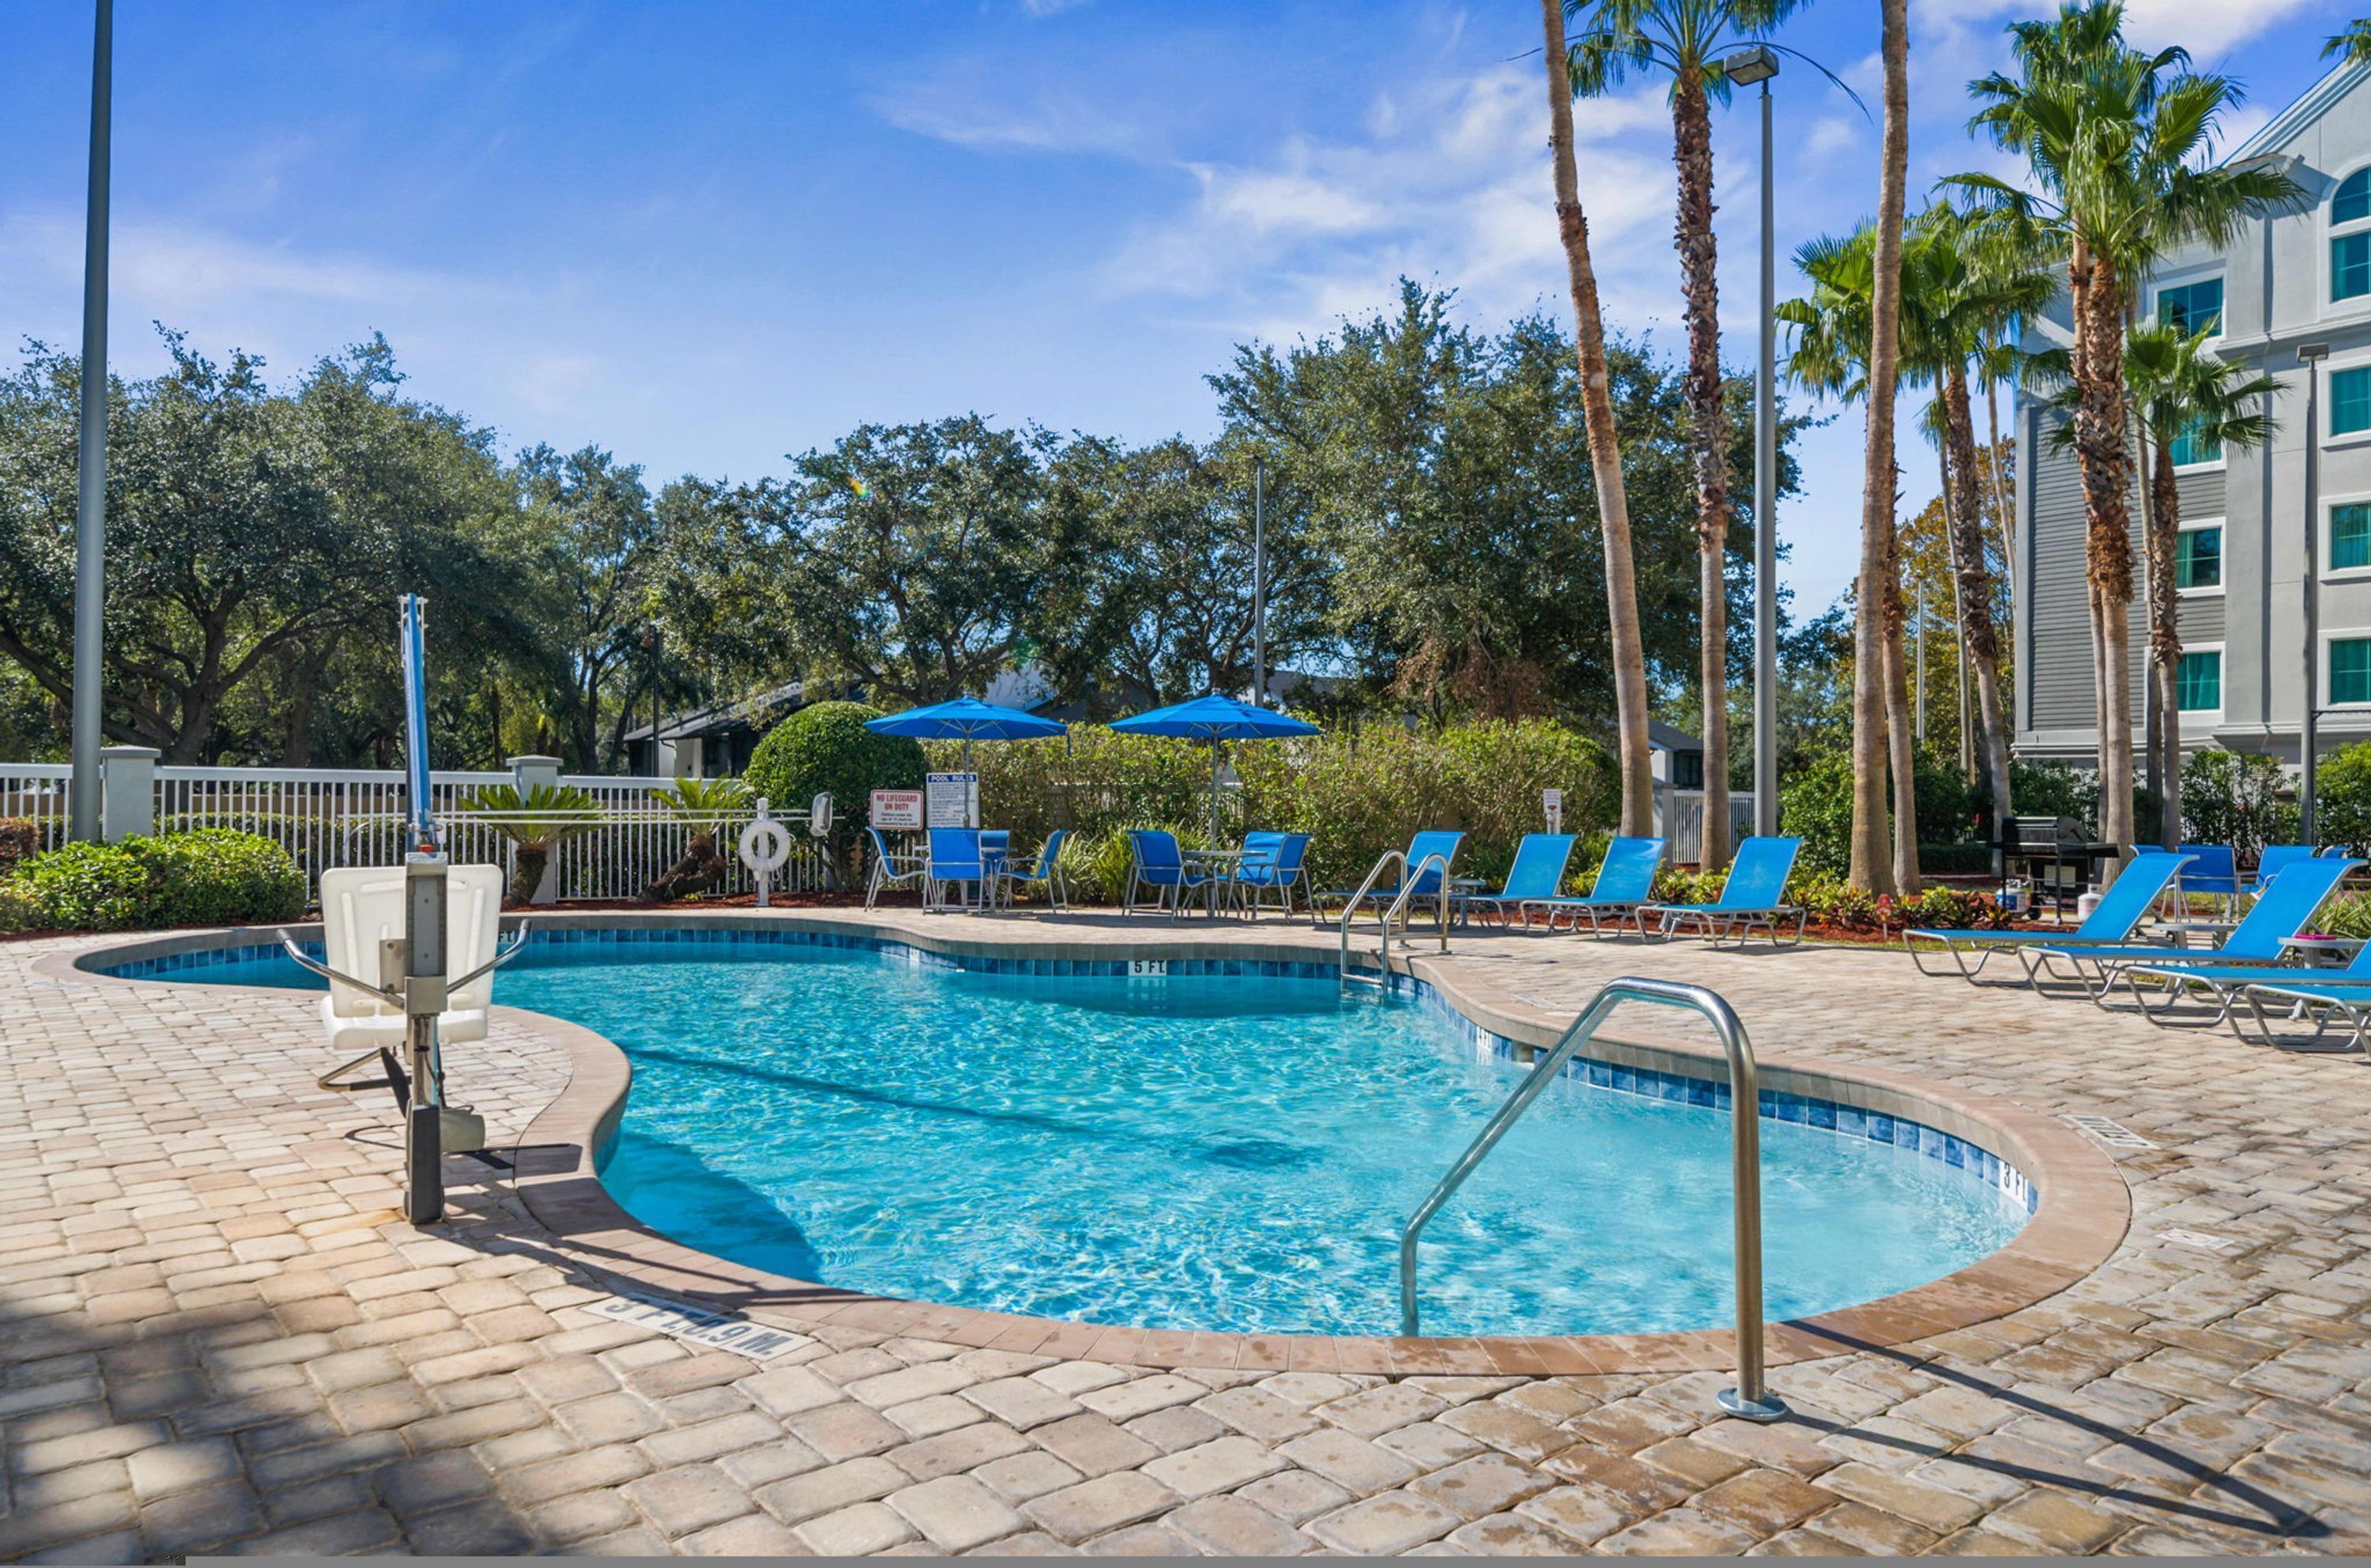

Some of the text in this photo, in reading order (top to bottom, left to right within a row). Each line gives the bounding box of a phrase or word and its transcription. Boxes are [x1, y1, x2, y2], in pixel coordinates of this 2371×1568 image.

[1134, 959, 1165, 974] 5 FT.
[2003, 1161, 2011, 1189] 3
[604, 1298, 650, 1314] 3
